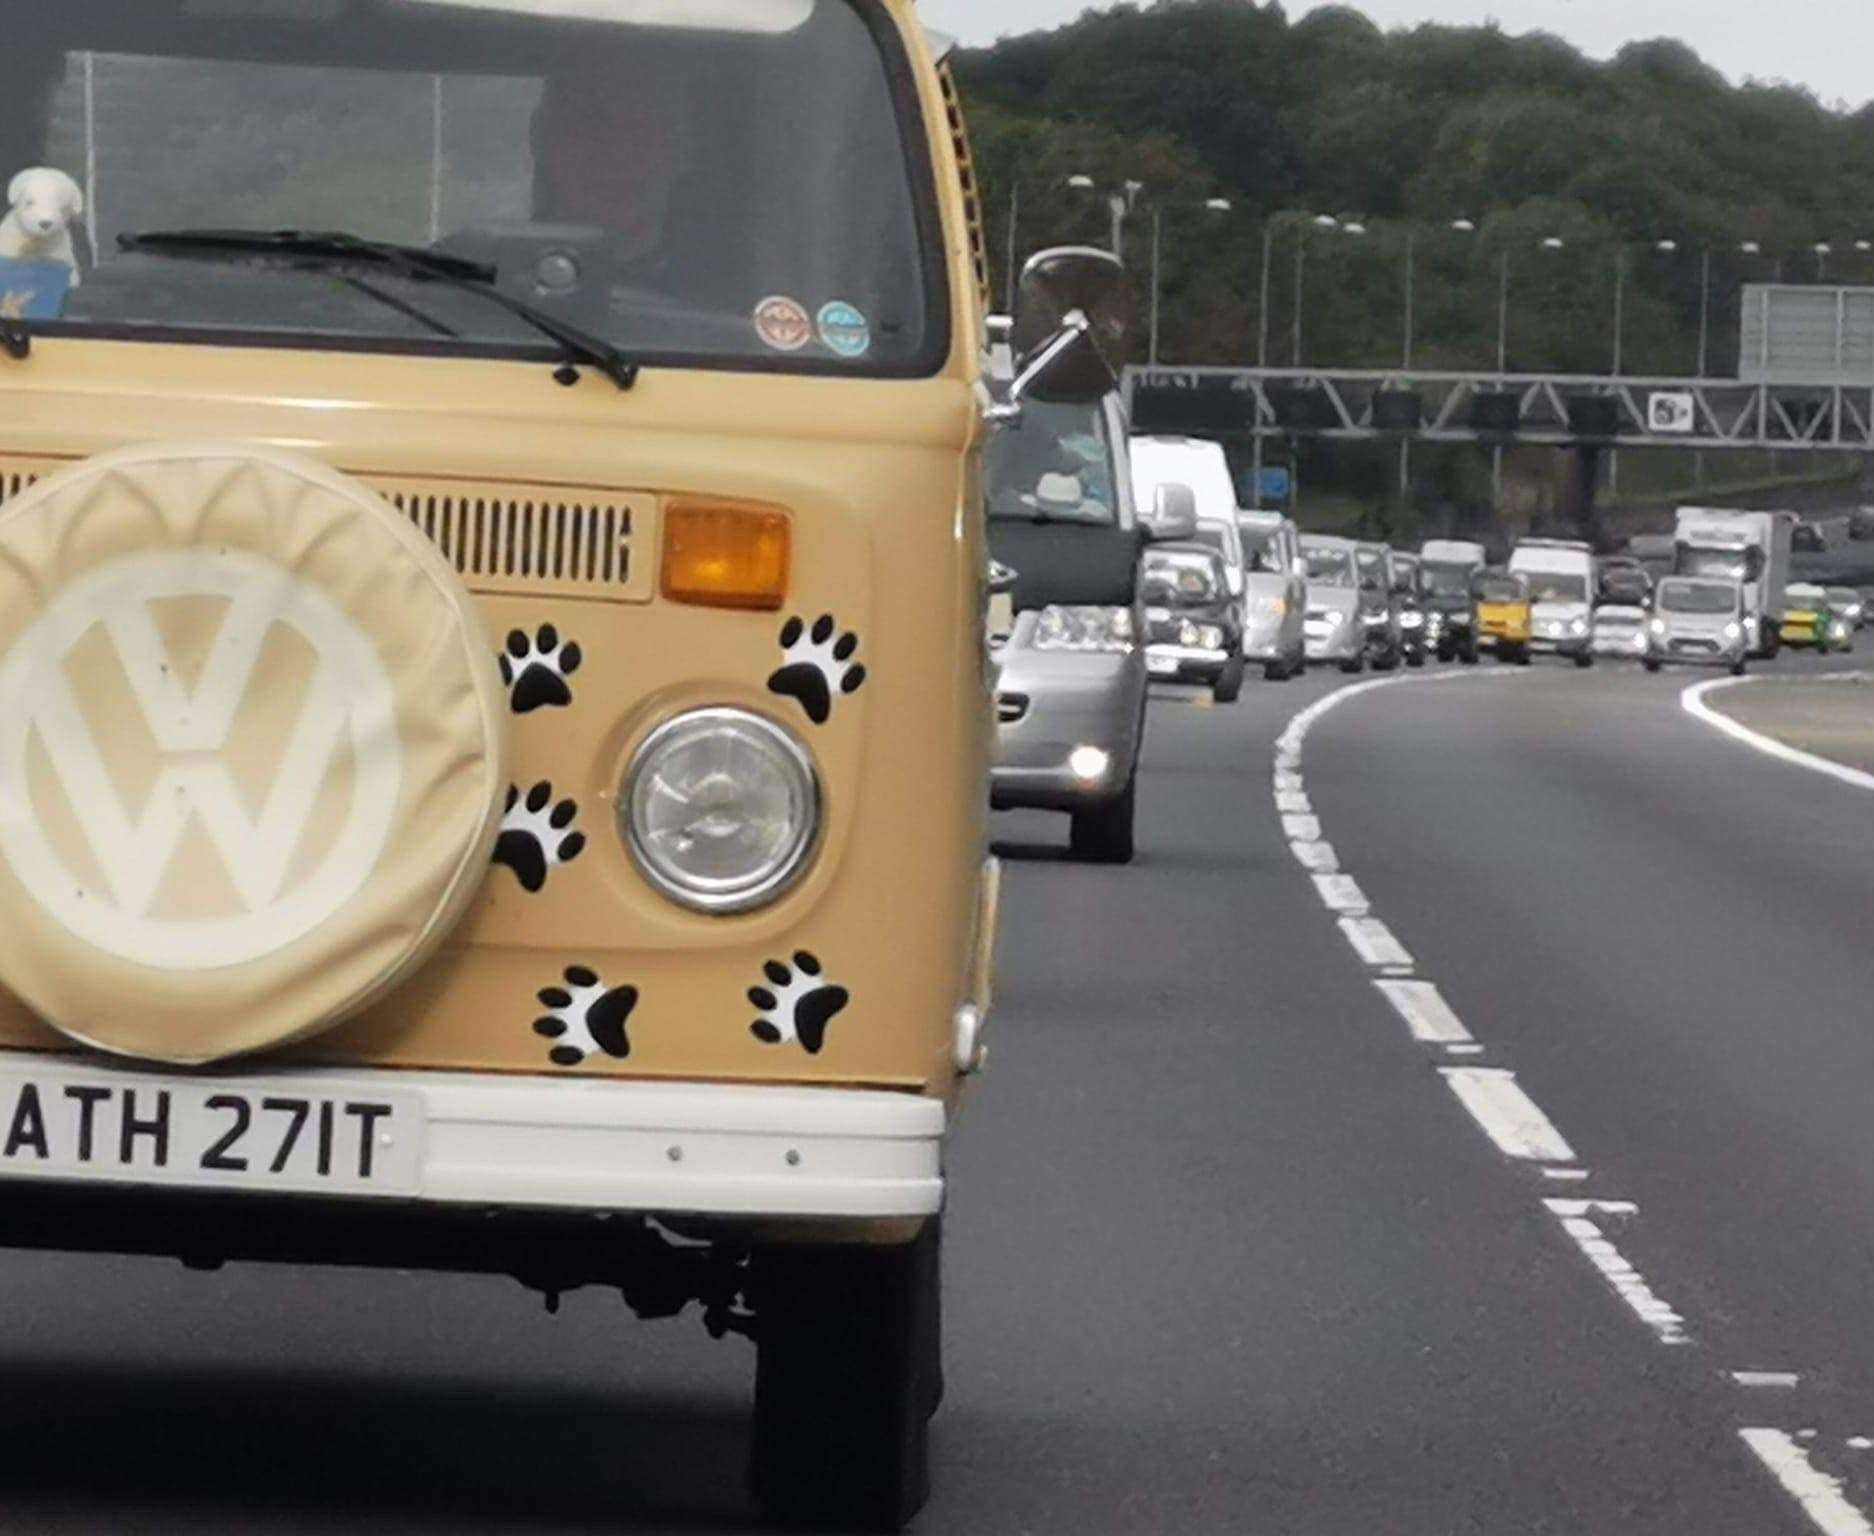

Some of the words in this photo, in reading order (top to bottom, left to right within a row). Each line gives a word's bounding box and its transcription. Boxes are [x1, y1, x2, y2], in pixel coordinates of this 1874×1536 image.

[8, 570, 375, 935] VW
[3, 1082, 171, 1167] ATH
[200, 1094, 393, 1178] 271T
